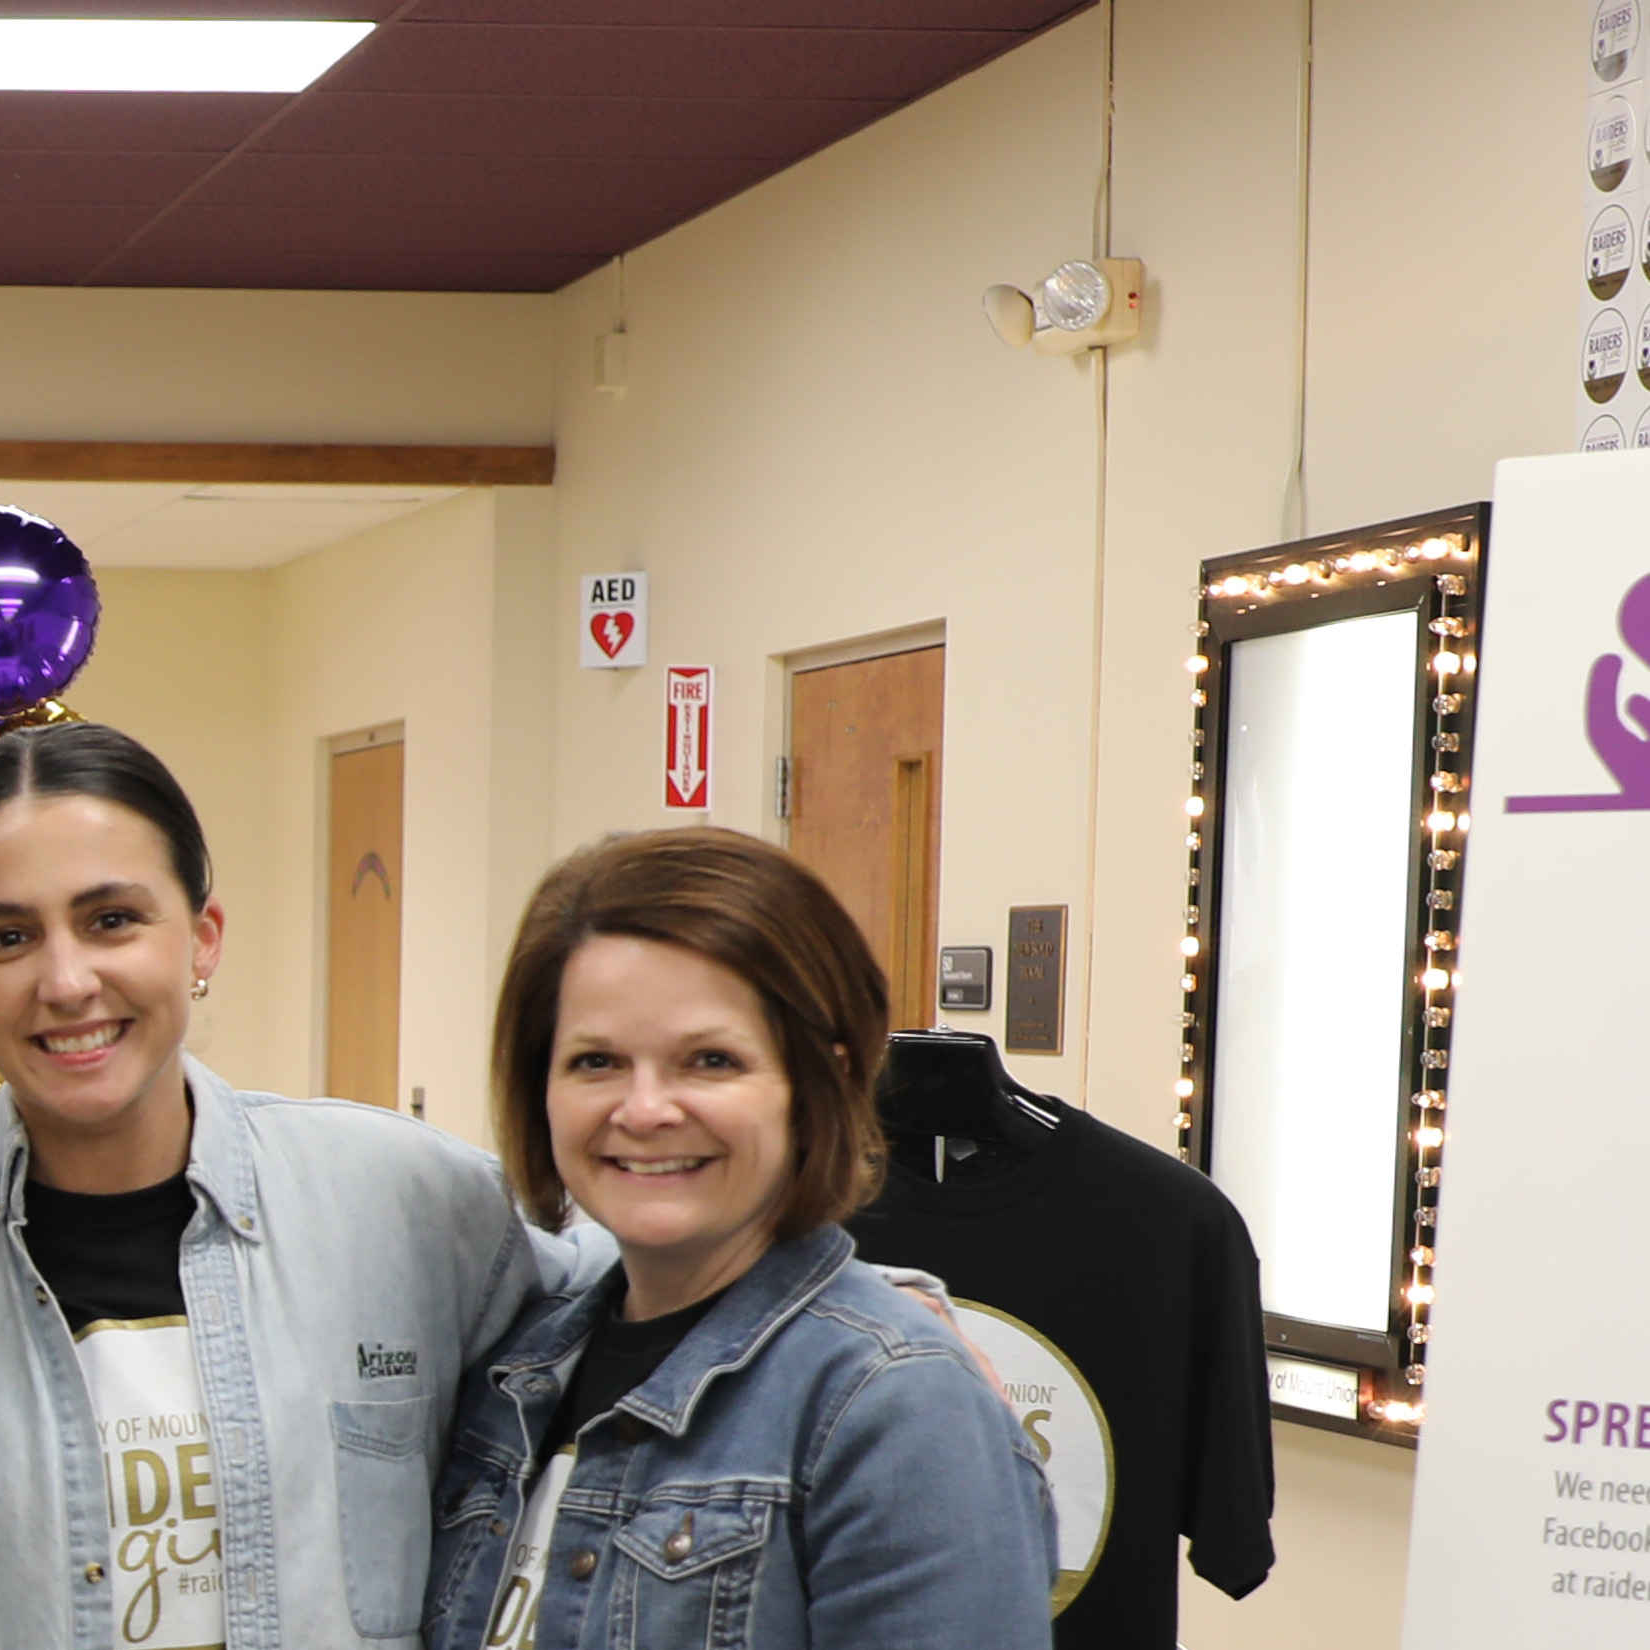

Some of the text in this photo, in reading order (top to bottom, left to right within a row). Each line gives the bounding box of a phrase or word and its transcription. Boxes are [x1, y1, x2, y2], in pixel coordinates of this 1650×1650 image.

[1593, 228, 1626, 252] RAIDERS
[1589, 332, 1624, 355] RAIDERS
[591, 577, 636, 603] AED
[673, 681, 704, 700] FIRE
[1275, 1370, 1287, 1390] of
[1289, 1372, 1323, 1396] Mount
[115, 1417, 141, 1443] OF
[1543, 1398, 1650, 1450] SPRE
[1554, 1470, 1592, 1500] We
[177, 1570, 224, 1594] #rai
[1551, 1571, 1576, 1595] at
